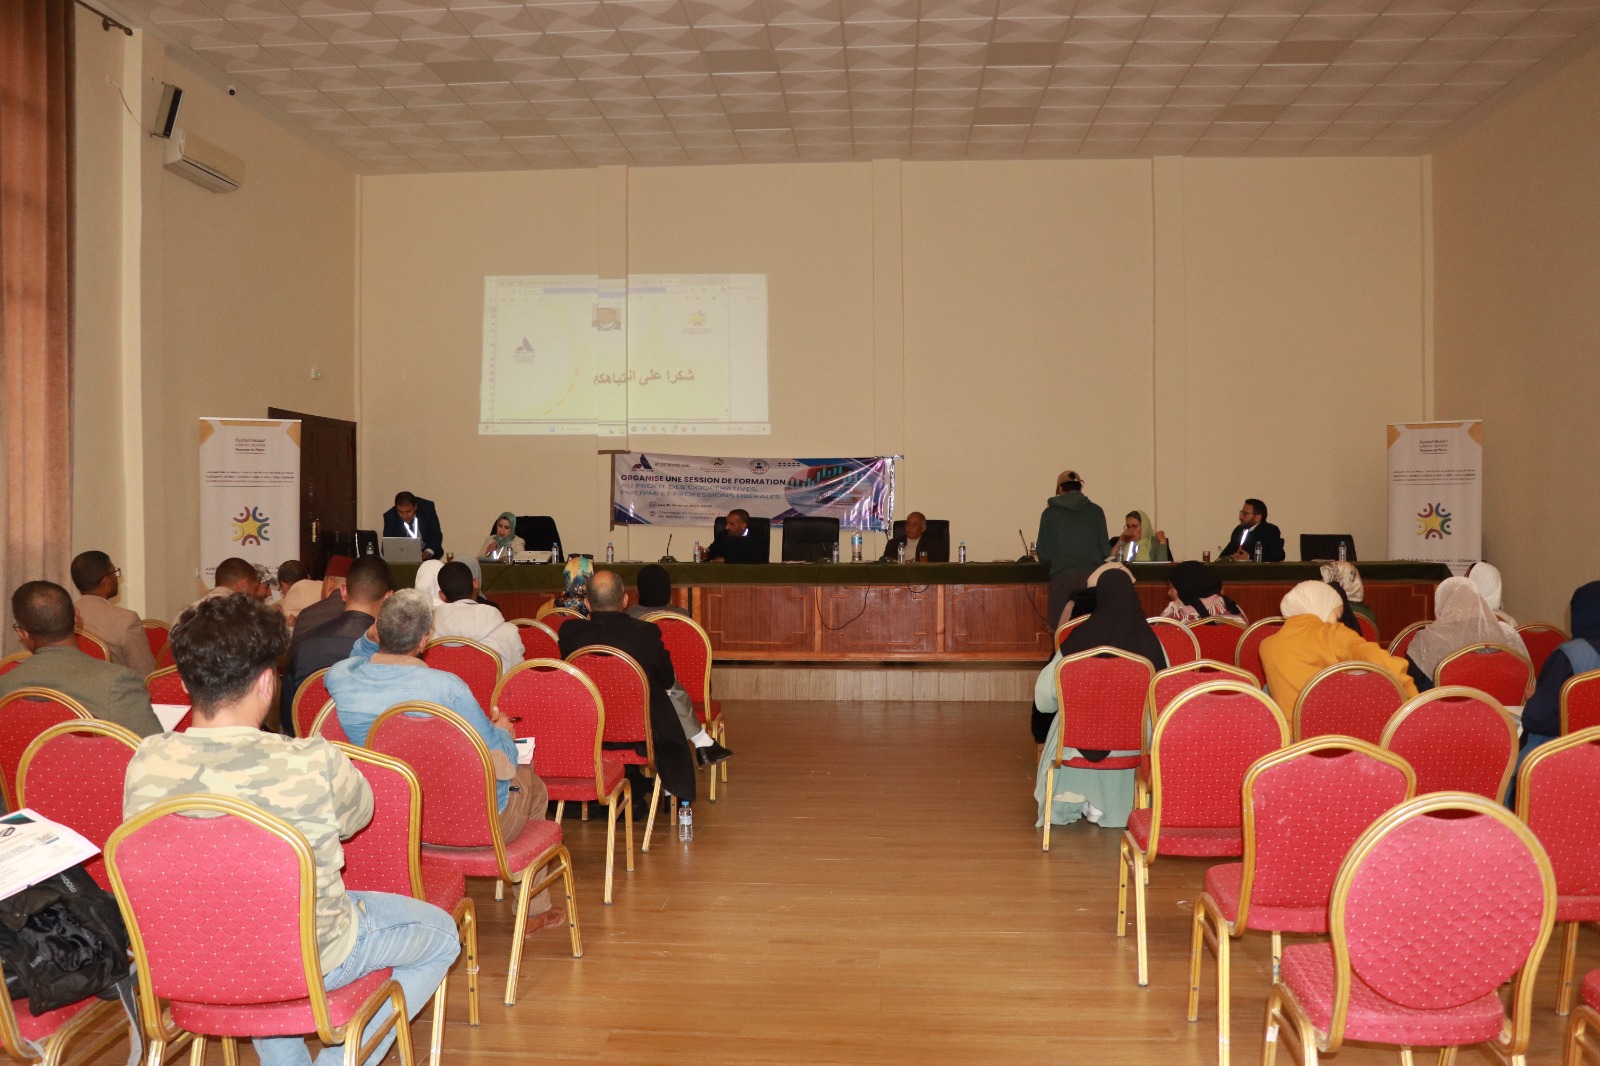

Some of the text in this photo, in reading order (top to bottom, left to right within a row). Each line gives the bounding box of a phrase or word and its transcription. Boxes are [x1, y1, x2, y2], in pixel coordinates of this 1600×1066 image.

[639, 368, 662, 385] على
[666, 368, 695, 383] شكرا
[620, 474, 664, 482] ORGANISE
[683, 476, 720, 484] SESSION
